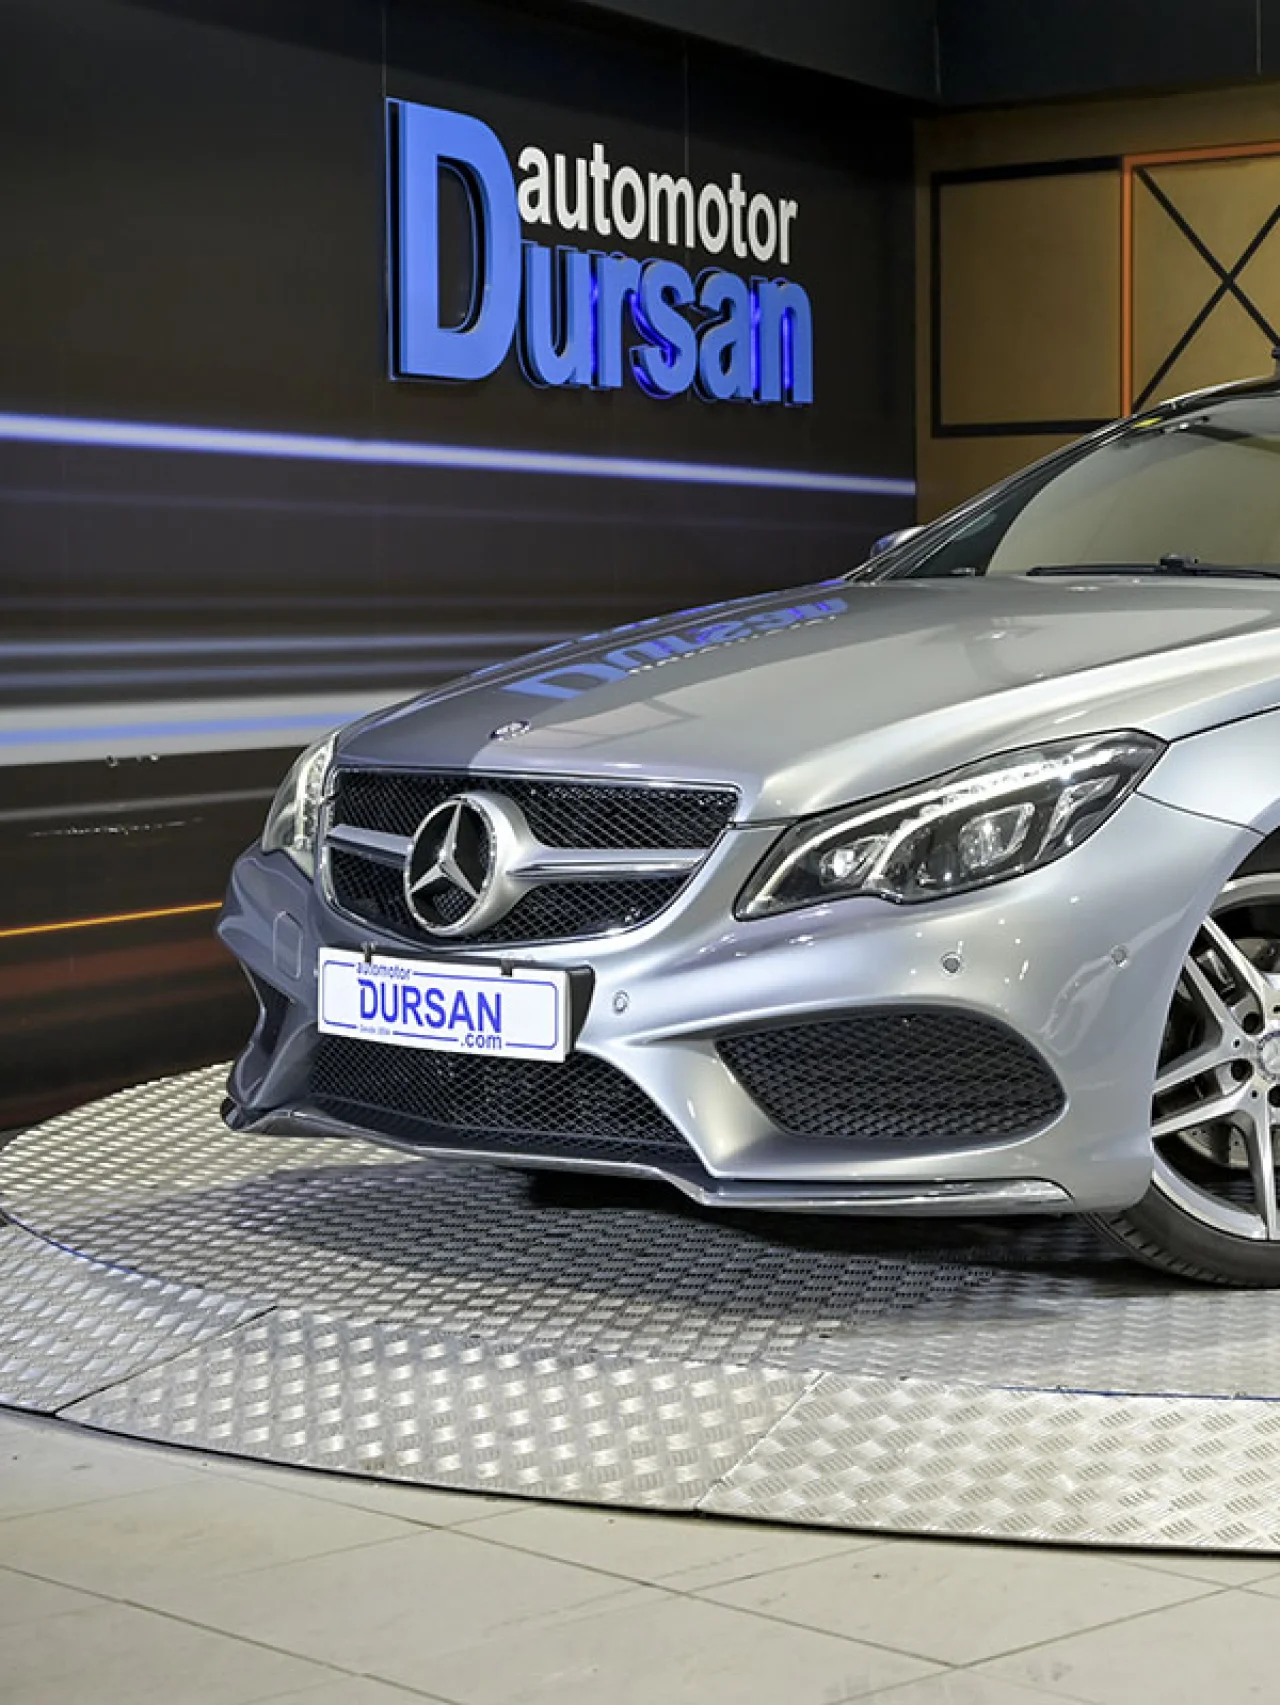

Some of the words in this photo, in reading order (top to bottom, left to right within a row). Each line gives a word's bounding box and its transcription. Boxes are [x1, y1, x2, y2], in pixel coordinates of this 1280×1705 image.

[518, 142, 798, 265] automotor
[386, 96, 814, 406] Dursan
[358, 980, 502, 1033] DURSAN
[460, 1033, 502, 1050] .com
